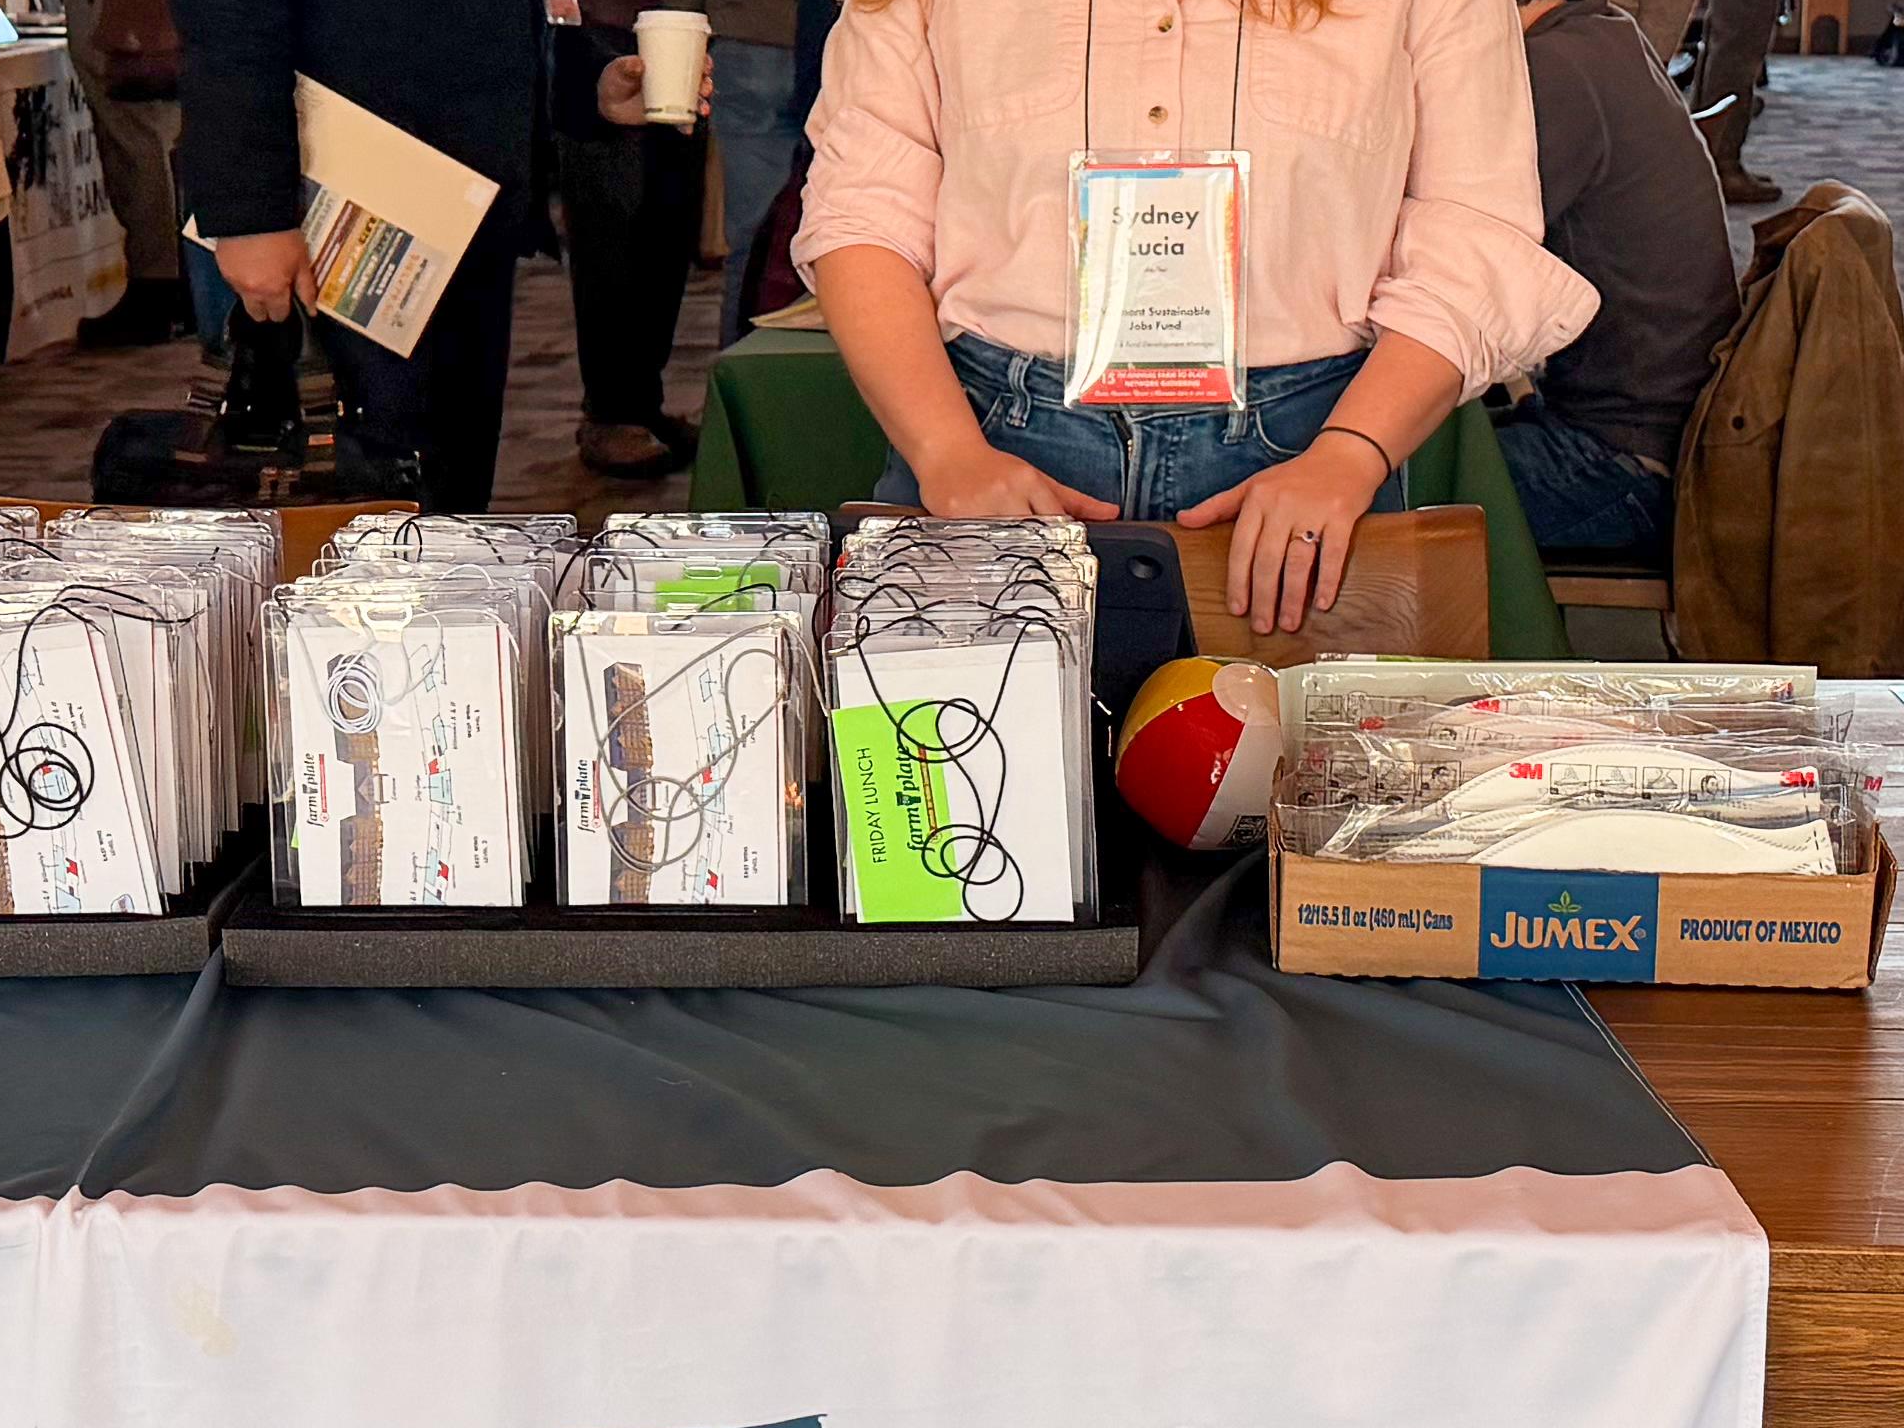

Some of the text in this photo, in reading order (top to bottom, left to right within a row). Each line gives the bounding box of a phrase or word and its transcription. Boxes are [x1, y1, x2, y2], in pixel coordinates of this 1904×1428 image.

[1112, 204, 1200, 230] Sydney
[1129, 236, 1185, 256] Lucia
[1148, 306, 1211, 317] Sustainable
[1129, 321, 1182, 331] Jobs Fund
[1508, 762, 1544, 780] 3M
[1780, 771, 1816, 789] 3M
[1863, 775, 1884, 791] M
[303, 752, 324, 827] farm plate
[575, 759, 596, 833] farm plate
[896, 745, 935, 852] farm plate
[857, 748, 887, 863] FRIDAY LUNCH
[1297, 903, 1340, 927] 12/15.5
[1341, 904, 1351, 928] fl
[1352, 911, 1367, 928] oz
[1368, 906, 1396, 932] (460
[1423, 907, 1454, 932] Cans
[1490, 909, 1643, 952] JUMEX
[1680, 917, 1842, 945] PRODUCT OF MEXICO
